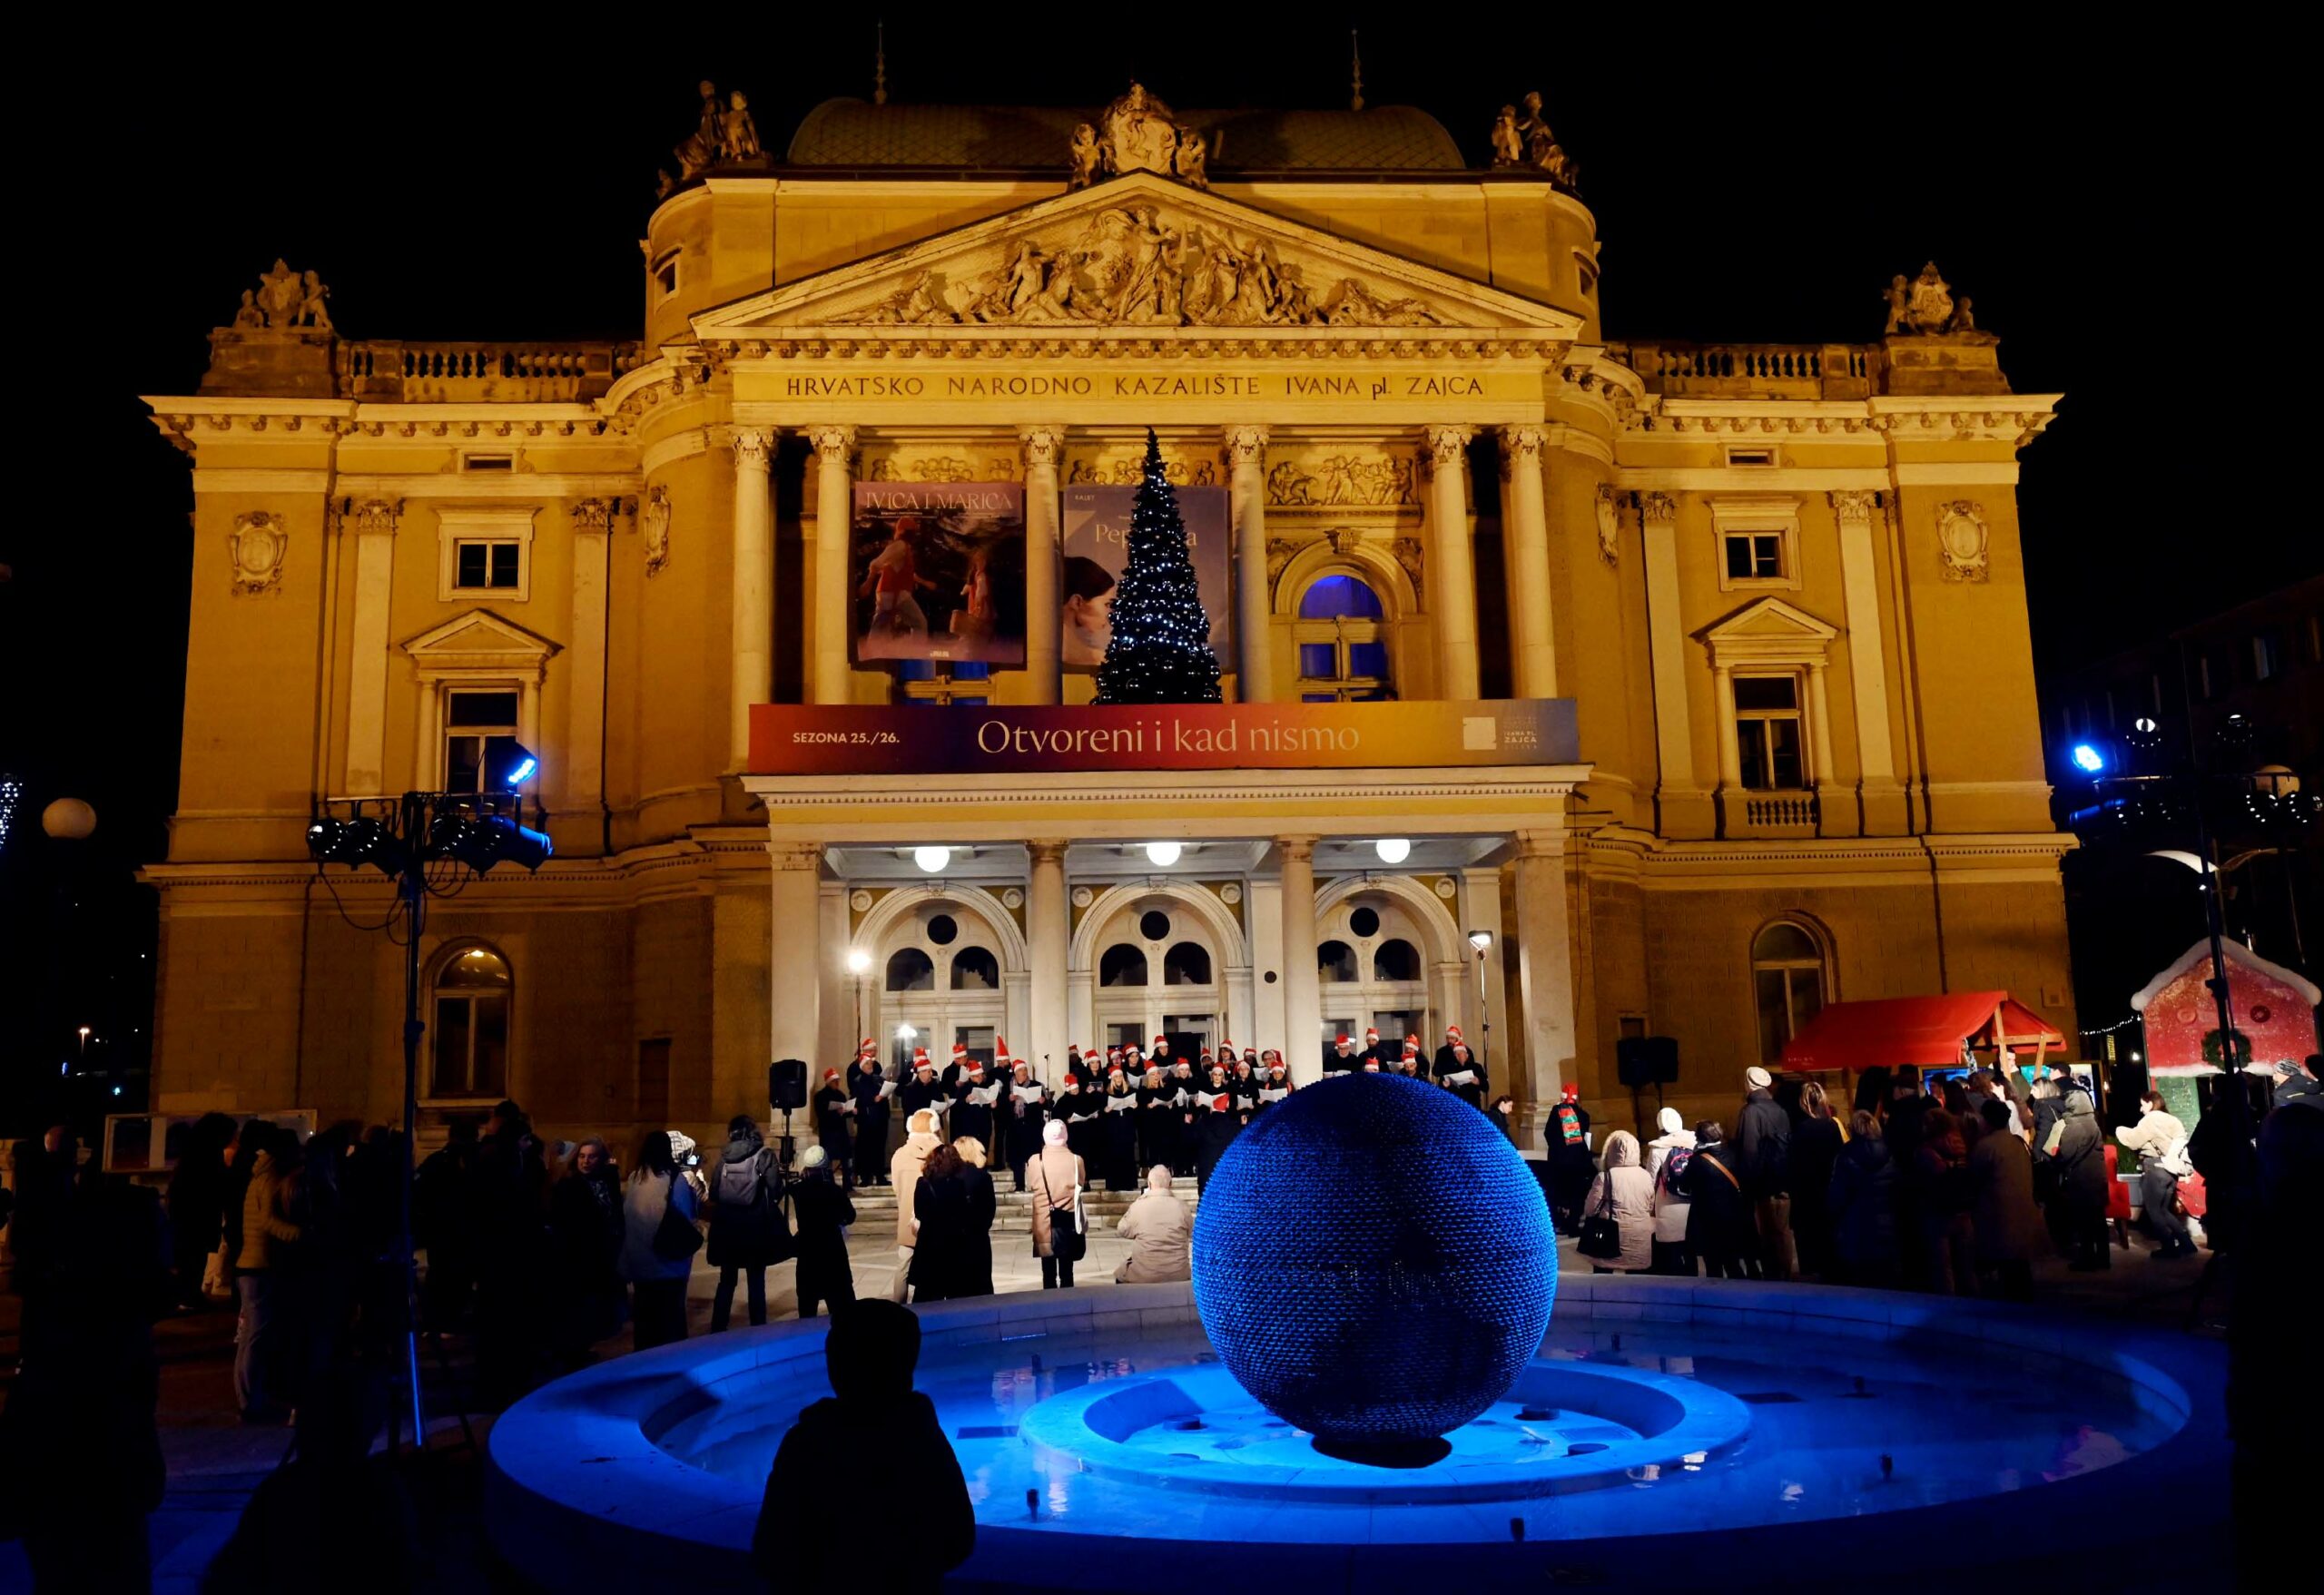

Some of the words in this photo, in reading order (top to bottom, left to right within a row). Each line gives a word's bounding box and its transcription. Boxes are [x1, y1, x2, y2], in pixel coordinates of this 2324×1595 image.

[787, 377, 924, 396] HRVATSKO
[948, 377, 1091, 395] NARODNO
[1115, 373, 1260, 395] KAZALIŠTE
[1285, 377, 1360, 395] IVANA
[1405, 377, 1483, 396] ZAJCA
[865, 491, 920, 509] IVICA
[923, 492, 931, 509] I
[936, 492, 1014, 509] MARICA
[793, 732, 848, 743] SEZONA
[850, 732, 901, 746] 25./26.
[978, 720, 1143, 753] Otvoreni
[1155, 720, 1162, 753] i
[1174, 719, 1237, 753] kad
[1249, 719, 1360, 752] nismo
